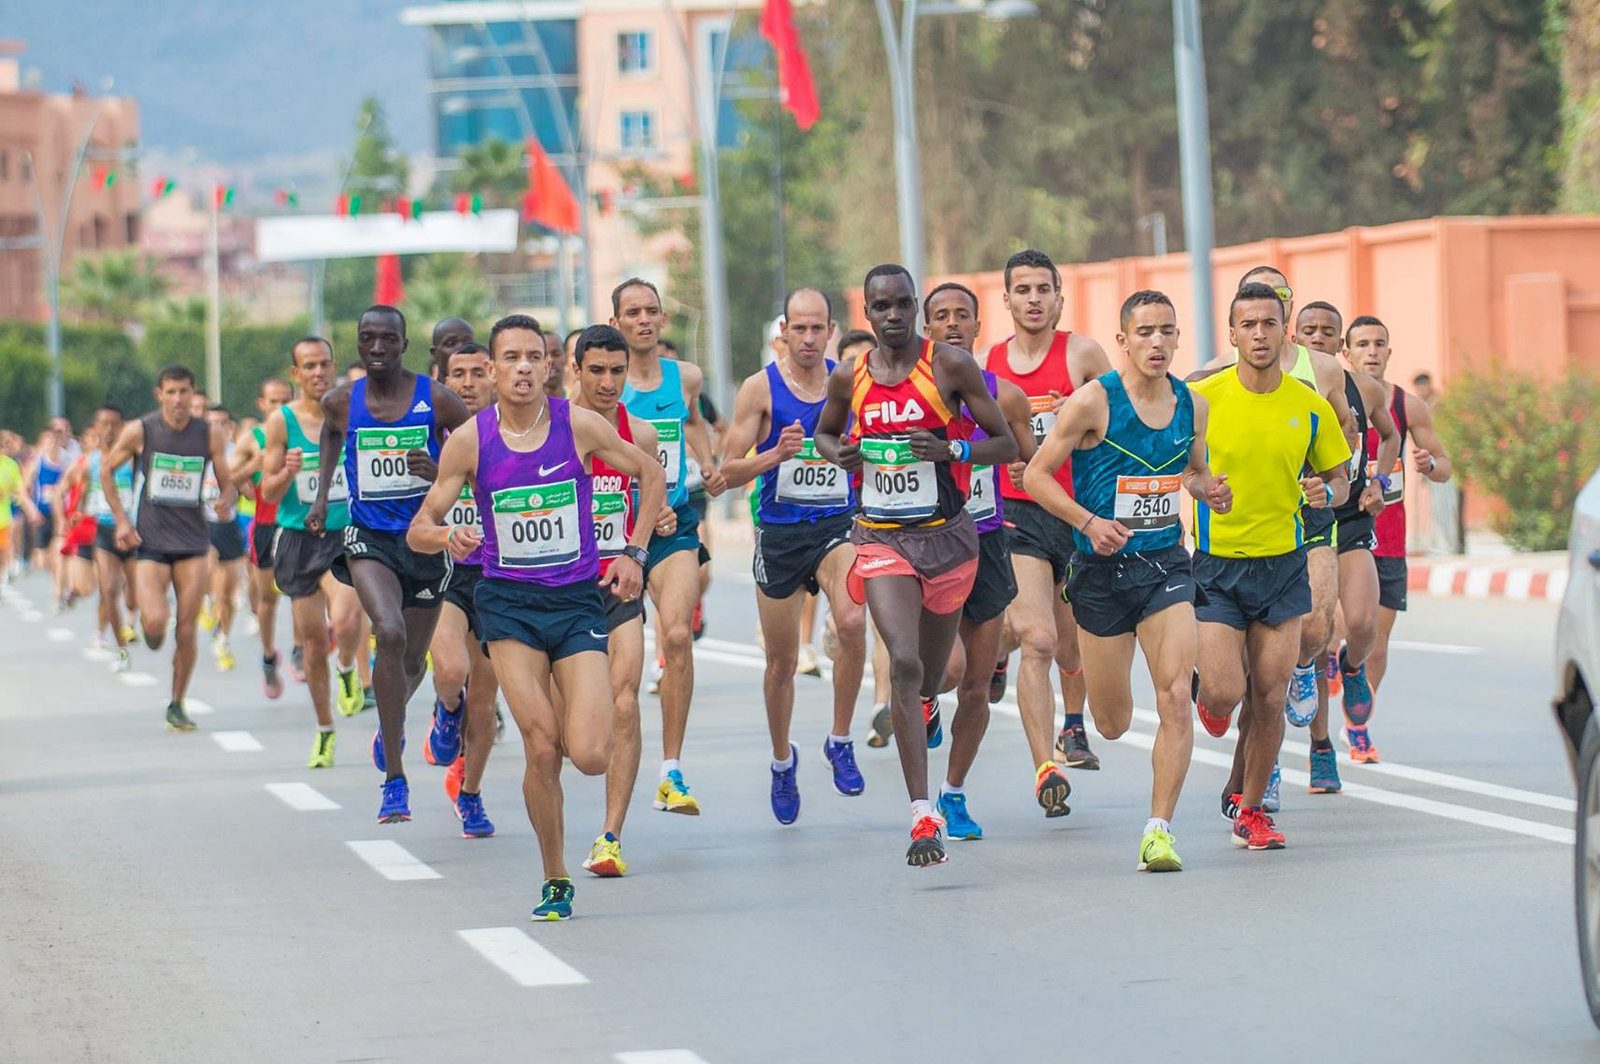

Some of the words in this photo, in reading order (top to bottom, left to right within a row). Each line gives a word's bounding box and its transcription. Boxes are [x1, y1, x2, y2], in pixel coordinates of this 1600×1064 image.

[864, 399, 925, 426] FILA
[371, 457, 406, 478] 000
[793, 466, 837, 487] 0052
[161, 475, 192, 490] 0553
[592, 476, 622, 491] OCCO
[875, 470, 920, 495] 0005
[453, 507, 483, 525] 005
[1133, 498, 1171, 517] 2540
[512, 516, 564, 543] 0001
[593, 522, 614, 541] 60
